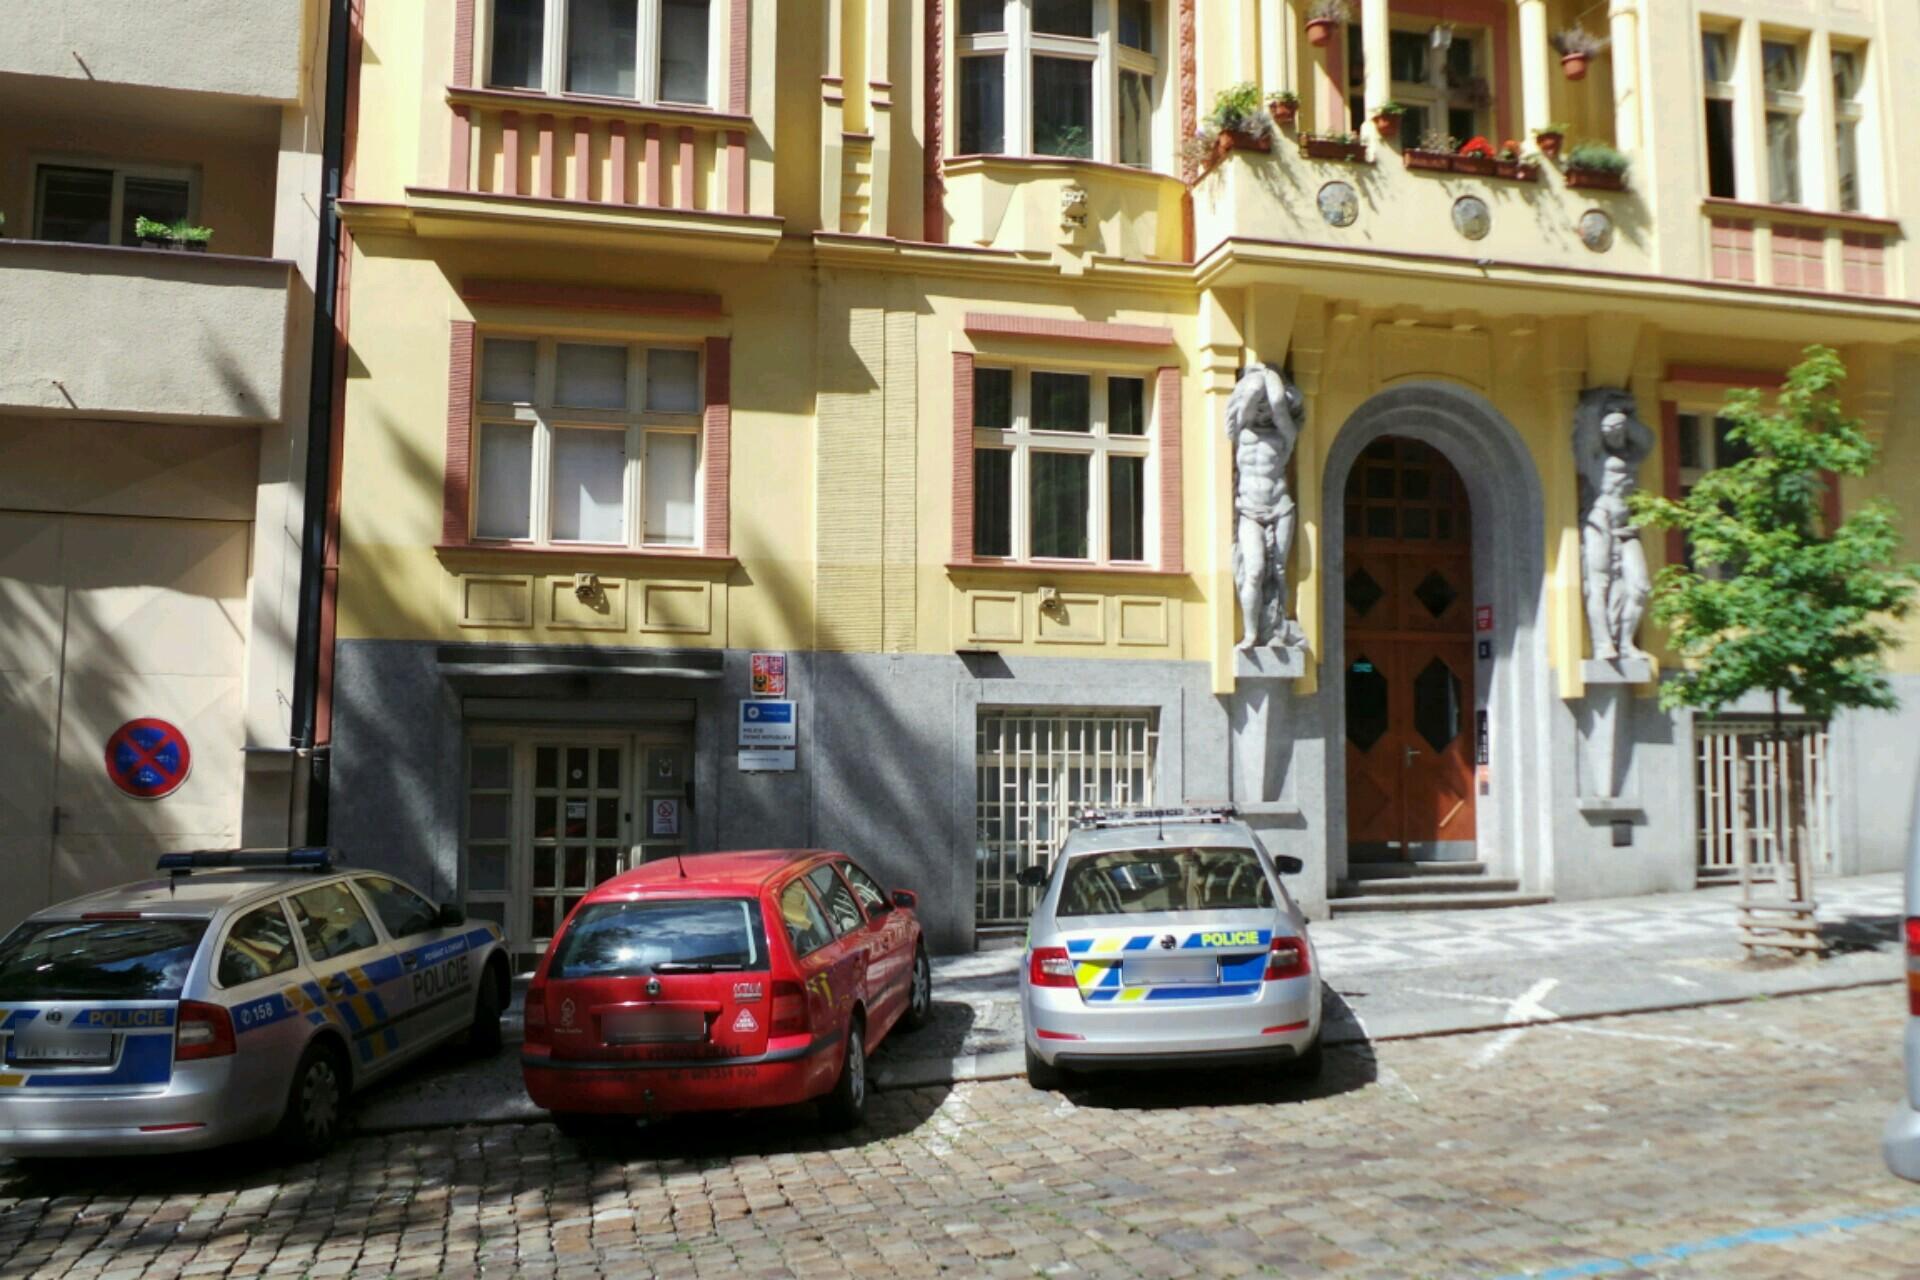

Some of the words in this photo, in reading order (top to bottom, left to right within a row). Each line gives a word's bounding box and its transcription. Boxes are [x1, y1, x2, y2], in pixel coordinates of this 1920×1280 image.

[1200, 930, 1259, 946] POLICIE
[413, 956, 469, 1003] POLICIE
[89, 1009, 167, 1026] POLICIE
[252, 1001, 274, 1021] 158
